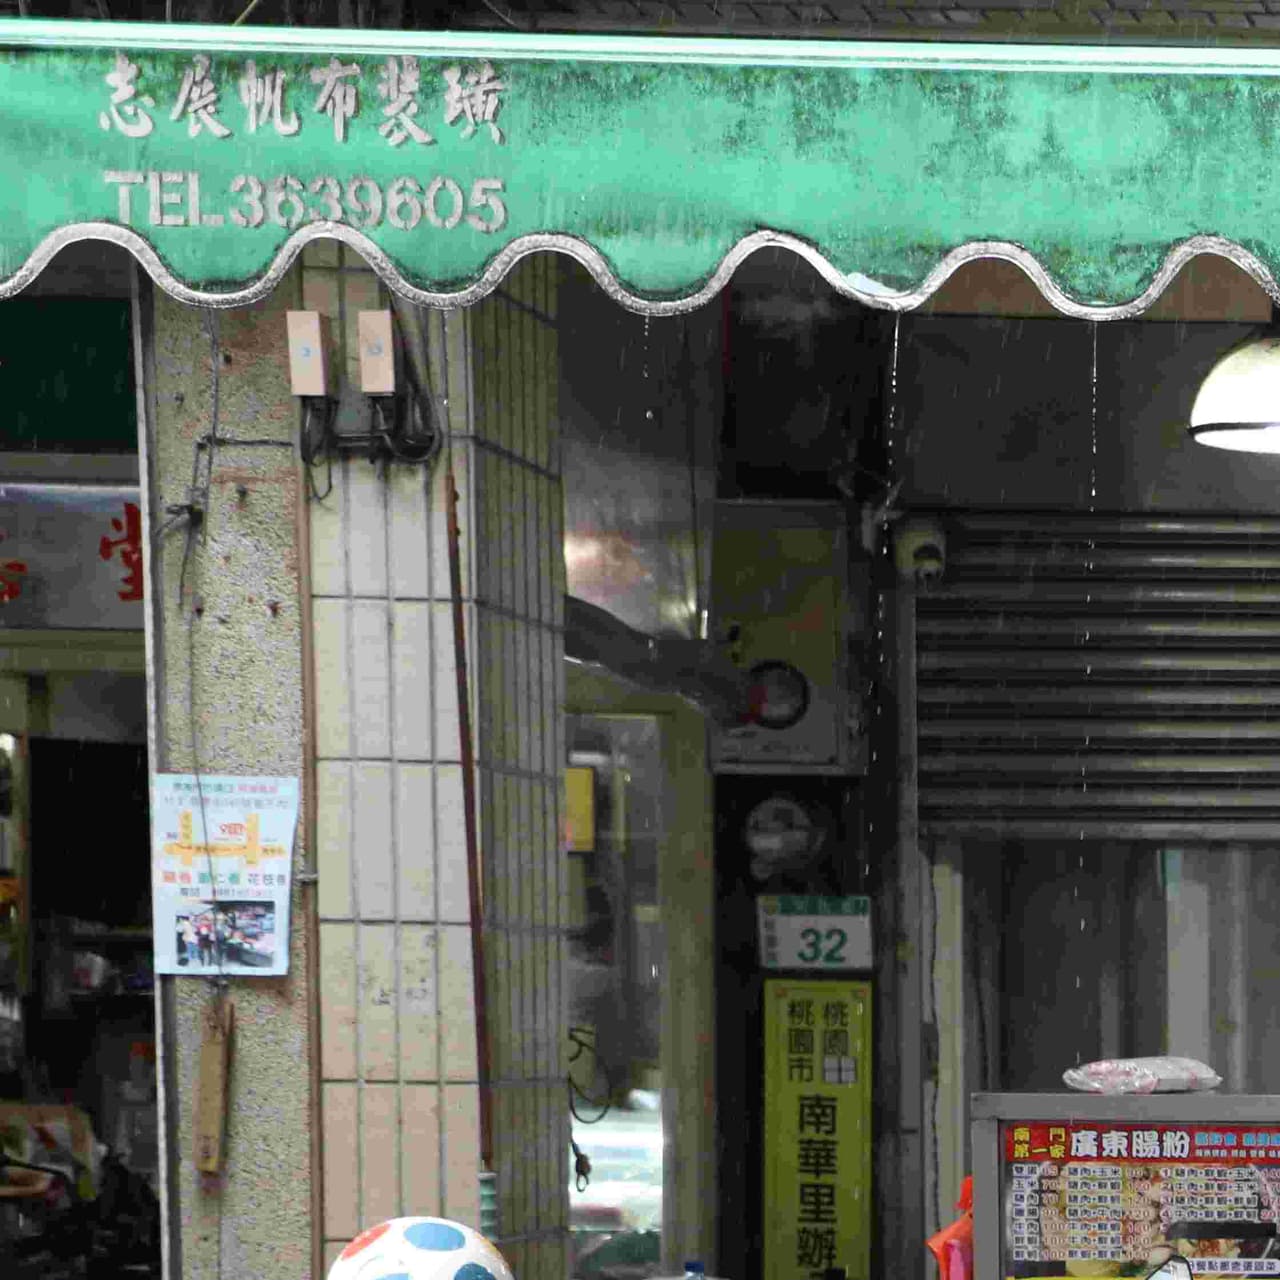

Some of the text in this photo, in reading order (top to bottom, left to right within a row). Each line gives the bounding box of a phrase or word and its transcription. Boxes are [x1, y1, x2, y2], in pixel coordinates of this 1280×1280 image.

[797, 928, 848, 963] 32
[1071, 1129, 1191, 1159] 廣東腸粉
[796, 1094, 839, 1280] 南華里辦
